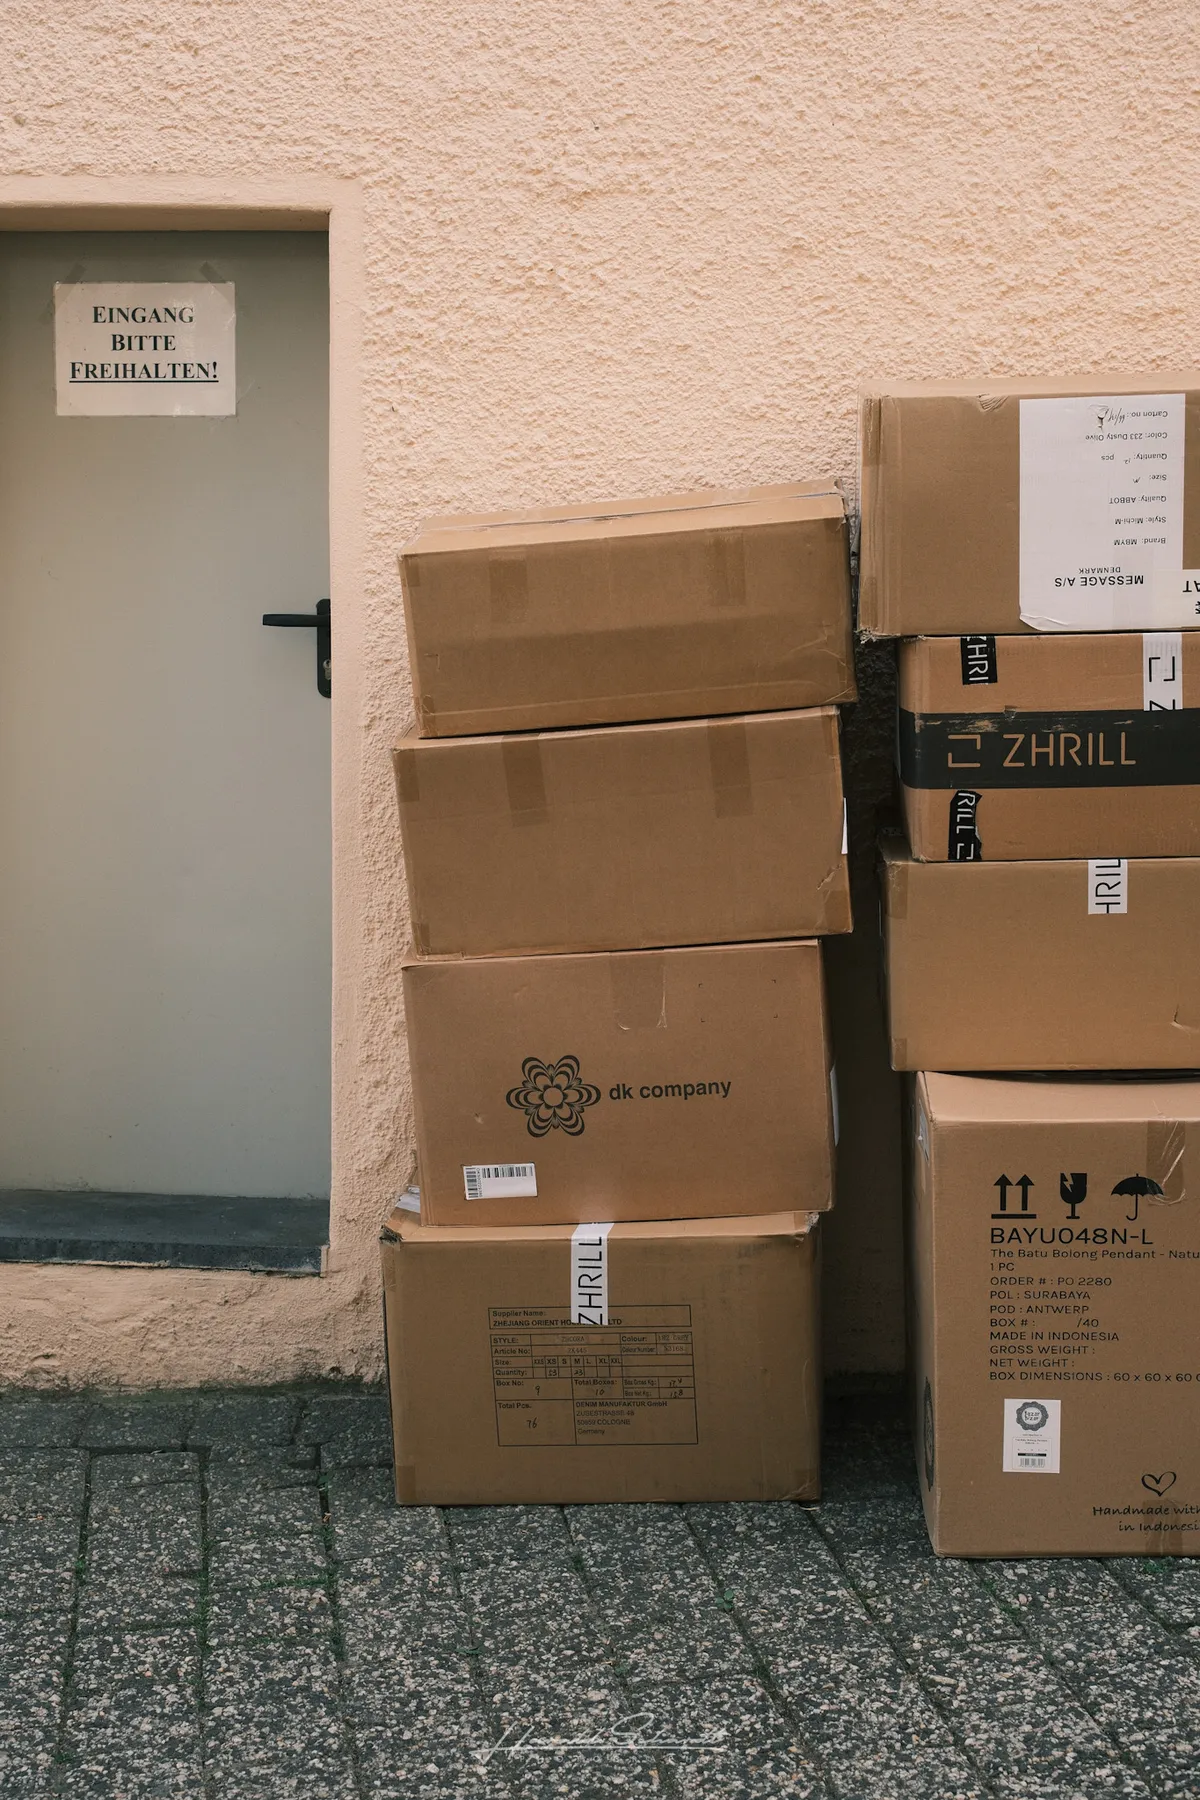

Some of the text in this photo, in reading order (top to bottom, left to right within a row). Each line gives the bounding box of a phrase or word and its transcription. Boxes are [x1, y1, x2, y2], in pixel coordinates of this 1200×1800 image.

[92, 306, 195, 323] EINGANG
[111, 334, 176, 351] BITTE
[70, 361, 218, 380] FREIHALTEN!
[1143, 410, 1168, 418] Carton
[1085, 431, 1168, 441] Color: 233 Dusty Olive
[1134, 452, 1168, 460] Quantity:
[1150, 473, 1167, 481] Size:
[1109, 495, 1167, 504] Quality: ABBOT
[1115, 516, 1167, 525] Style: Michi-M
[1055, 575, 1144, 587] MESSAGE A/S
[967, 636, 988, 681] HRI
[1002, 732, 1136, 767] ZHRILL
[609, 1081, 732, 1100] dk company
[990, 1227, 1153, 1245] BAYU048N-L
[990, 1249, 1014, 1258] The
[1018, 1249, 1048, 1258] Batu
[1052, 1249, 1098, 1261] Bolong
[1102, 1249, 1156, 1259] Pendant
[1169, 1250, 1200, 1259] Natu
[990, 1262, 1015, 1271] 1 PC
[578, 1237, 602, 1325] ZHRILL
[990, 1277, 1034, 1286] ORDER
[1057, 1277, 1075, 1286] PO
[1078, 1277, 1112, 1286] 2280
[990, 1291, 1013, 1300] POL
[1024, 1291, 1091, 1300] SURABAYA
[493, 1310, 521, 1318] Supplier
[990, 1305, 1016, 1314] POD
[1026, 1305, 1089, 1314] ANTWERP
[493, 1319, 530, 1327] ZHEJIANG
[990, 1319, 1016, 1328] BOX
[1020, 1319, 1028, 1327] #
[1076, 1318, 1099, 1328] /40
[493, 1336, 519, 1344] STYLE:
[622, 1335, 647, 1343] Colour:
[990, 1332, 1120, 1341] MADE IN INDONESIA
[494, 1347, 516, 1355] Article
[990, 1345, 1034, 1355] GROSS
[1038, 1345, 1089, 1355] WEIGHT
[598, 1357, 608, 1365] XL
[610, 1357, 622, 1365] XXL
[989, 1359, 1013, 1367] NET
[1018, 1359, 1069, 1367] WEIGHT
[495, 1369, 527, 1377] Quantity:
[989, 1372, 1016, 1381] BOX
[1020, 1372, 1103, 1381] DIMENSIONS
[1114, 1372, 1130, 1382] 60
[1145, 1373, 1161, 1382] 60
[1165, 1374, 1172, 1382] x
[1176, 1373, 1192, 1383] 60
[527, 1417, 538, 1429] 76
[597, 1418, 631, 1426] COLOGNE
[1092, 1505, 1170, 1516] Handmade
[1118, 1520, 1200, 1531] in Indonesi
